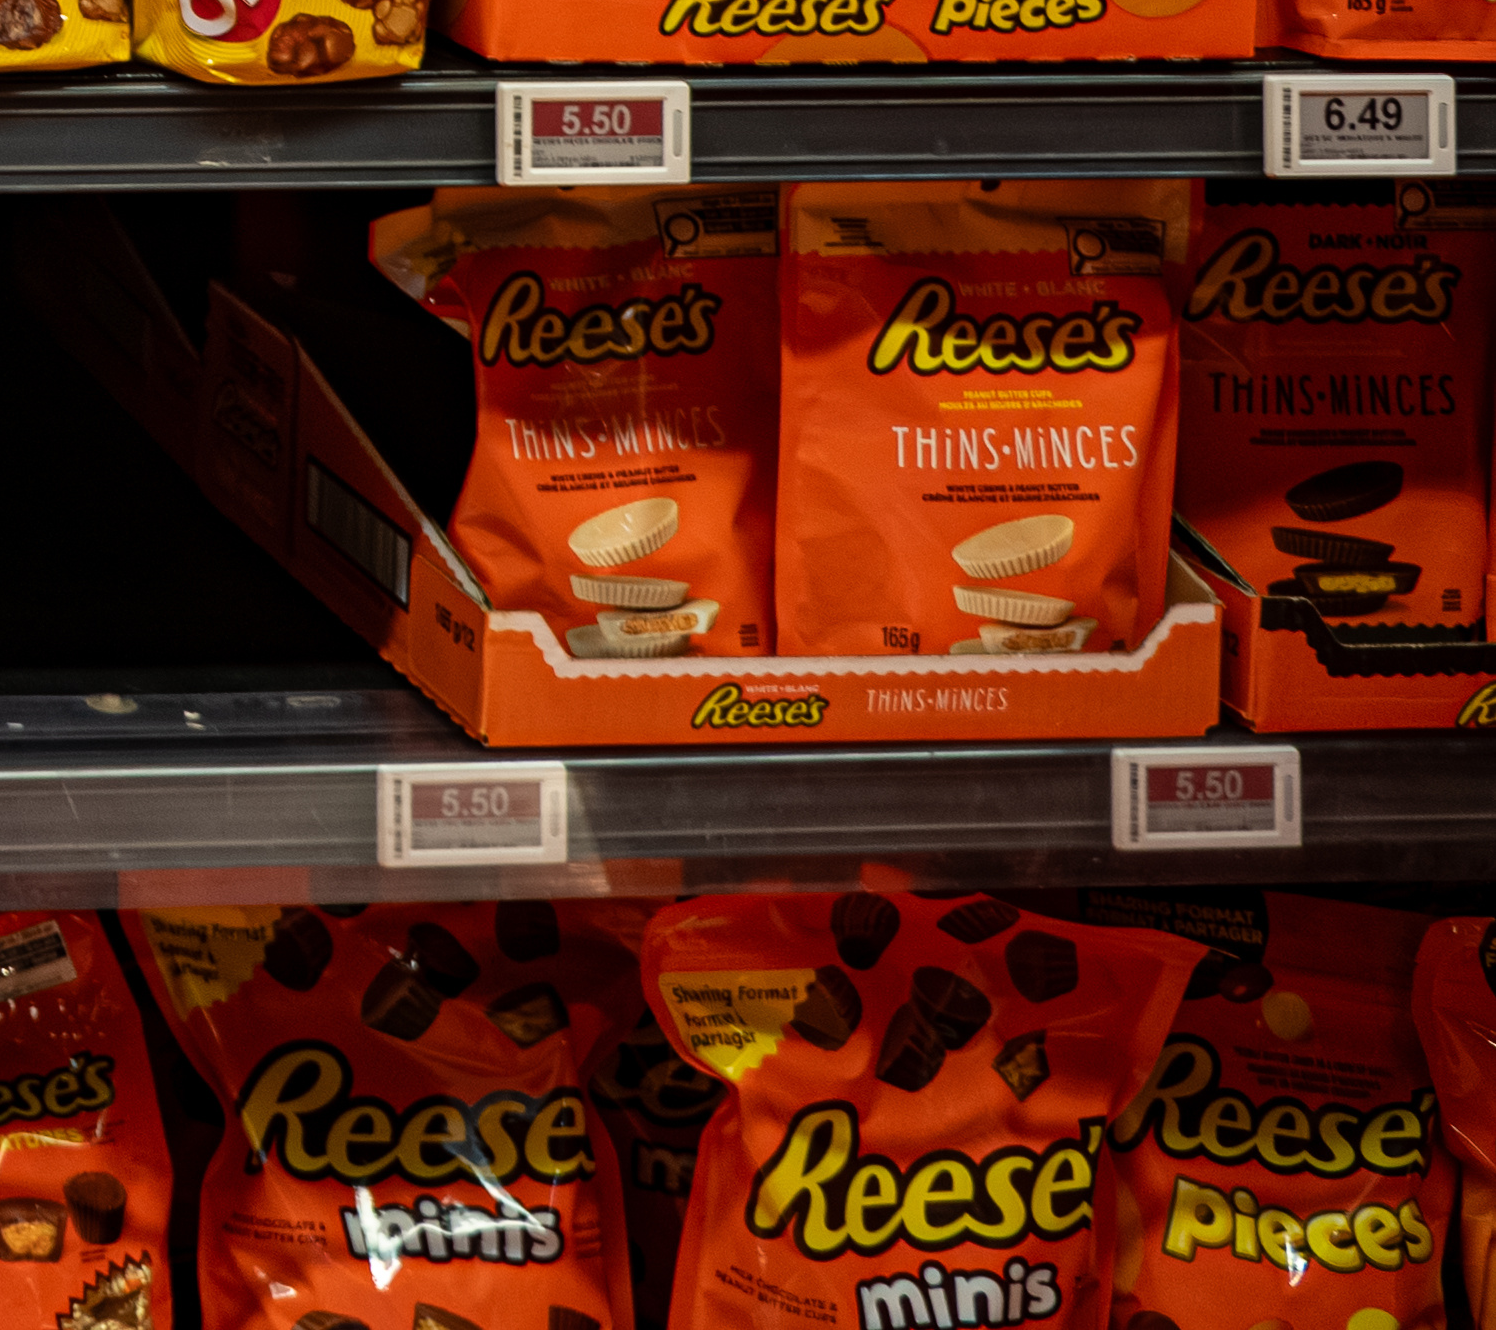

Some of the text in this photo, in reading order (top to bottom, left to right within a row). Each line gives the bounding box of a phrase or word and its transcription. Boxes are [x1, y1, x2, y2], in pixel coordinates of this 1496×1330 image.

[562, 105, 631, 136] 5.50
[1324, 98, 1402, 132] 6.49
[1175, 770, 1243, 801] 5.50
[441, 786, 510, 818] 5.50
[1168, 1177, 1431, 1271] pieces
